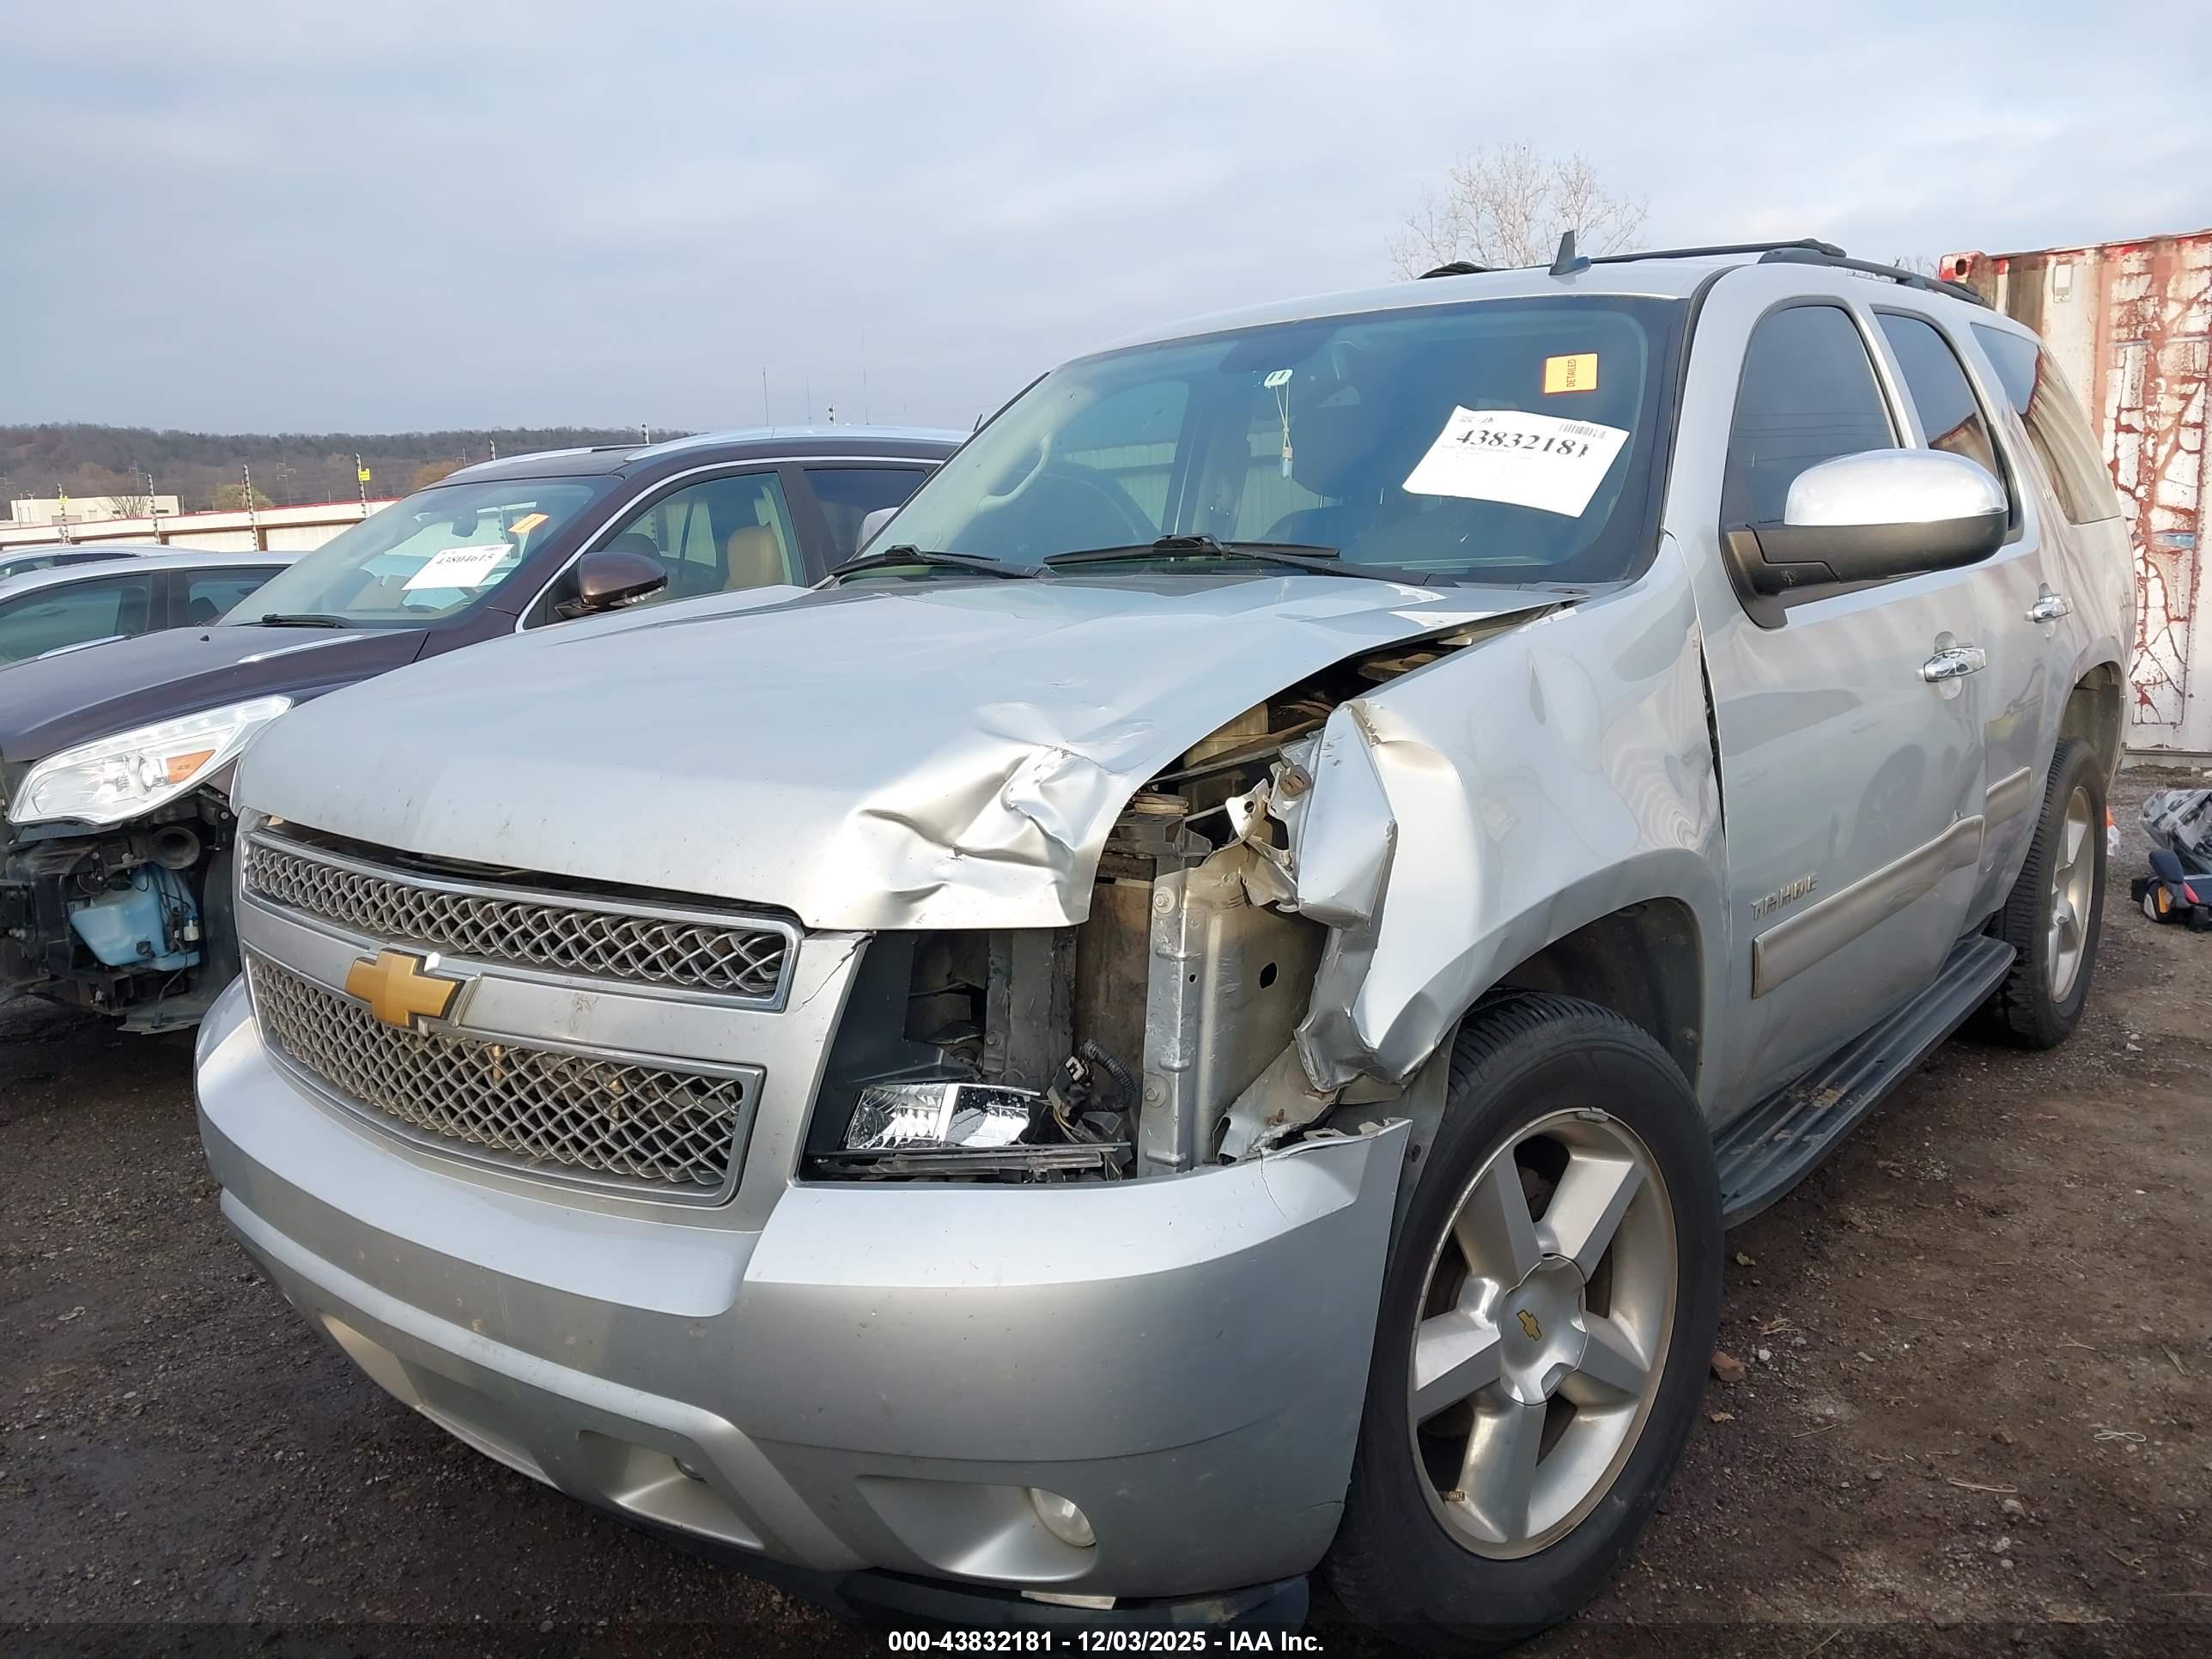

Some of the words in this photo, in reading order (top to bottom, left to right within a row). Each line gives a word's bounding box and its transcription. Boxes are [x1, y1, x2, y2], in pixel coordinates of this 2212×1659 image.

[1565, 358, 1577, 387] DETAILED
[1455, 429, 1589, 458] 43832181
[1751, 872, 1818, 921] TAHOE
